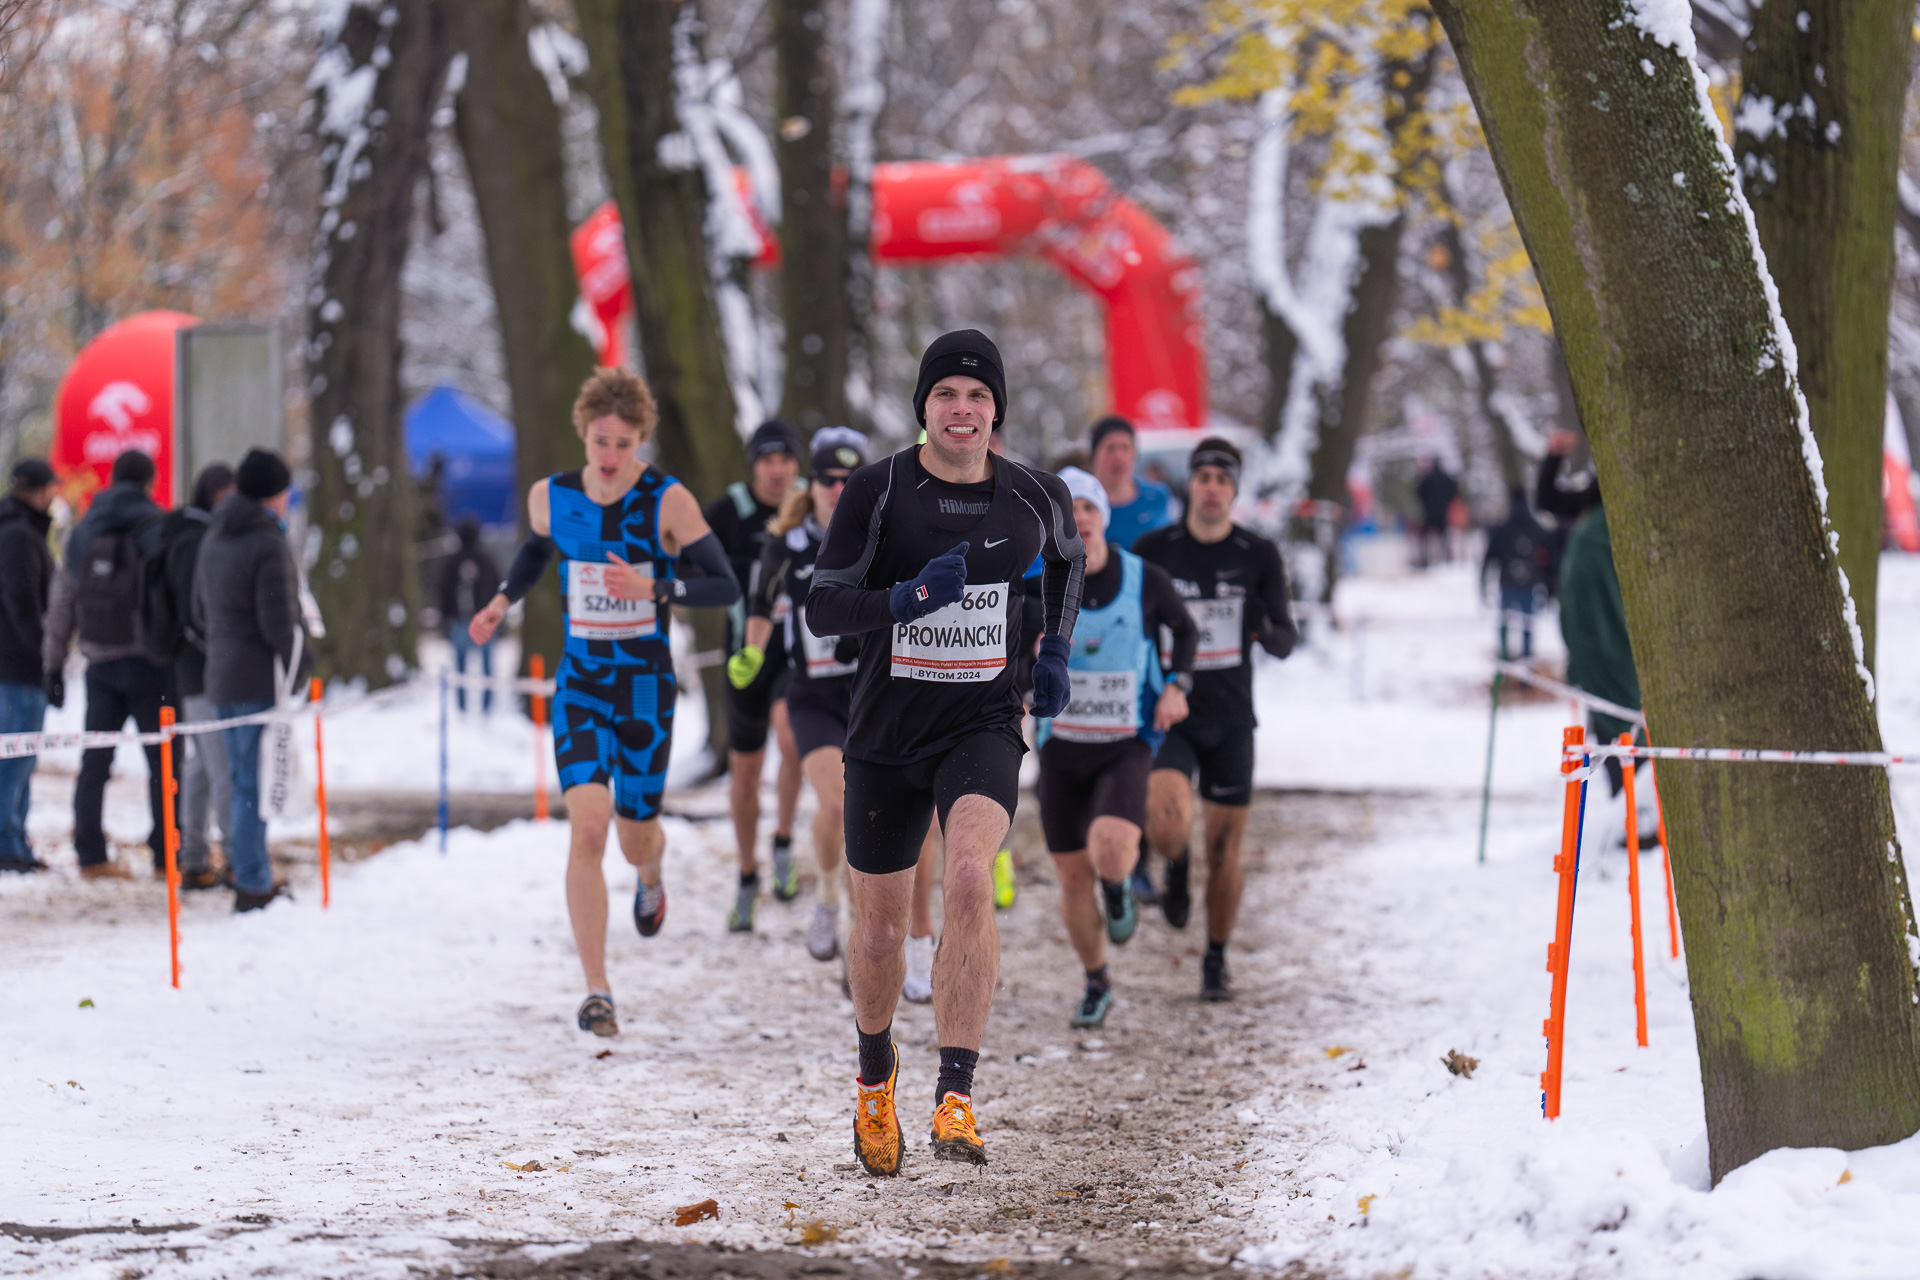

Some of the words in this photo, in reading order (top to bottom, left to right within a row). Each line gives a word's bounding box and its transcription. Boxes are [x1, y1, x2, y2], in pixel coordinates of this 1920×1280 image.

[961, 590, 999, 611] 660
[918, 669, 955, 680] BYTOM
[957, 671, 981, 680] 2024
